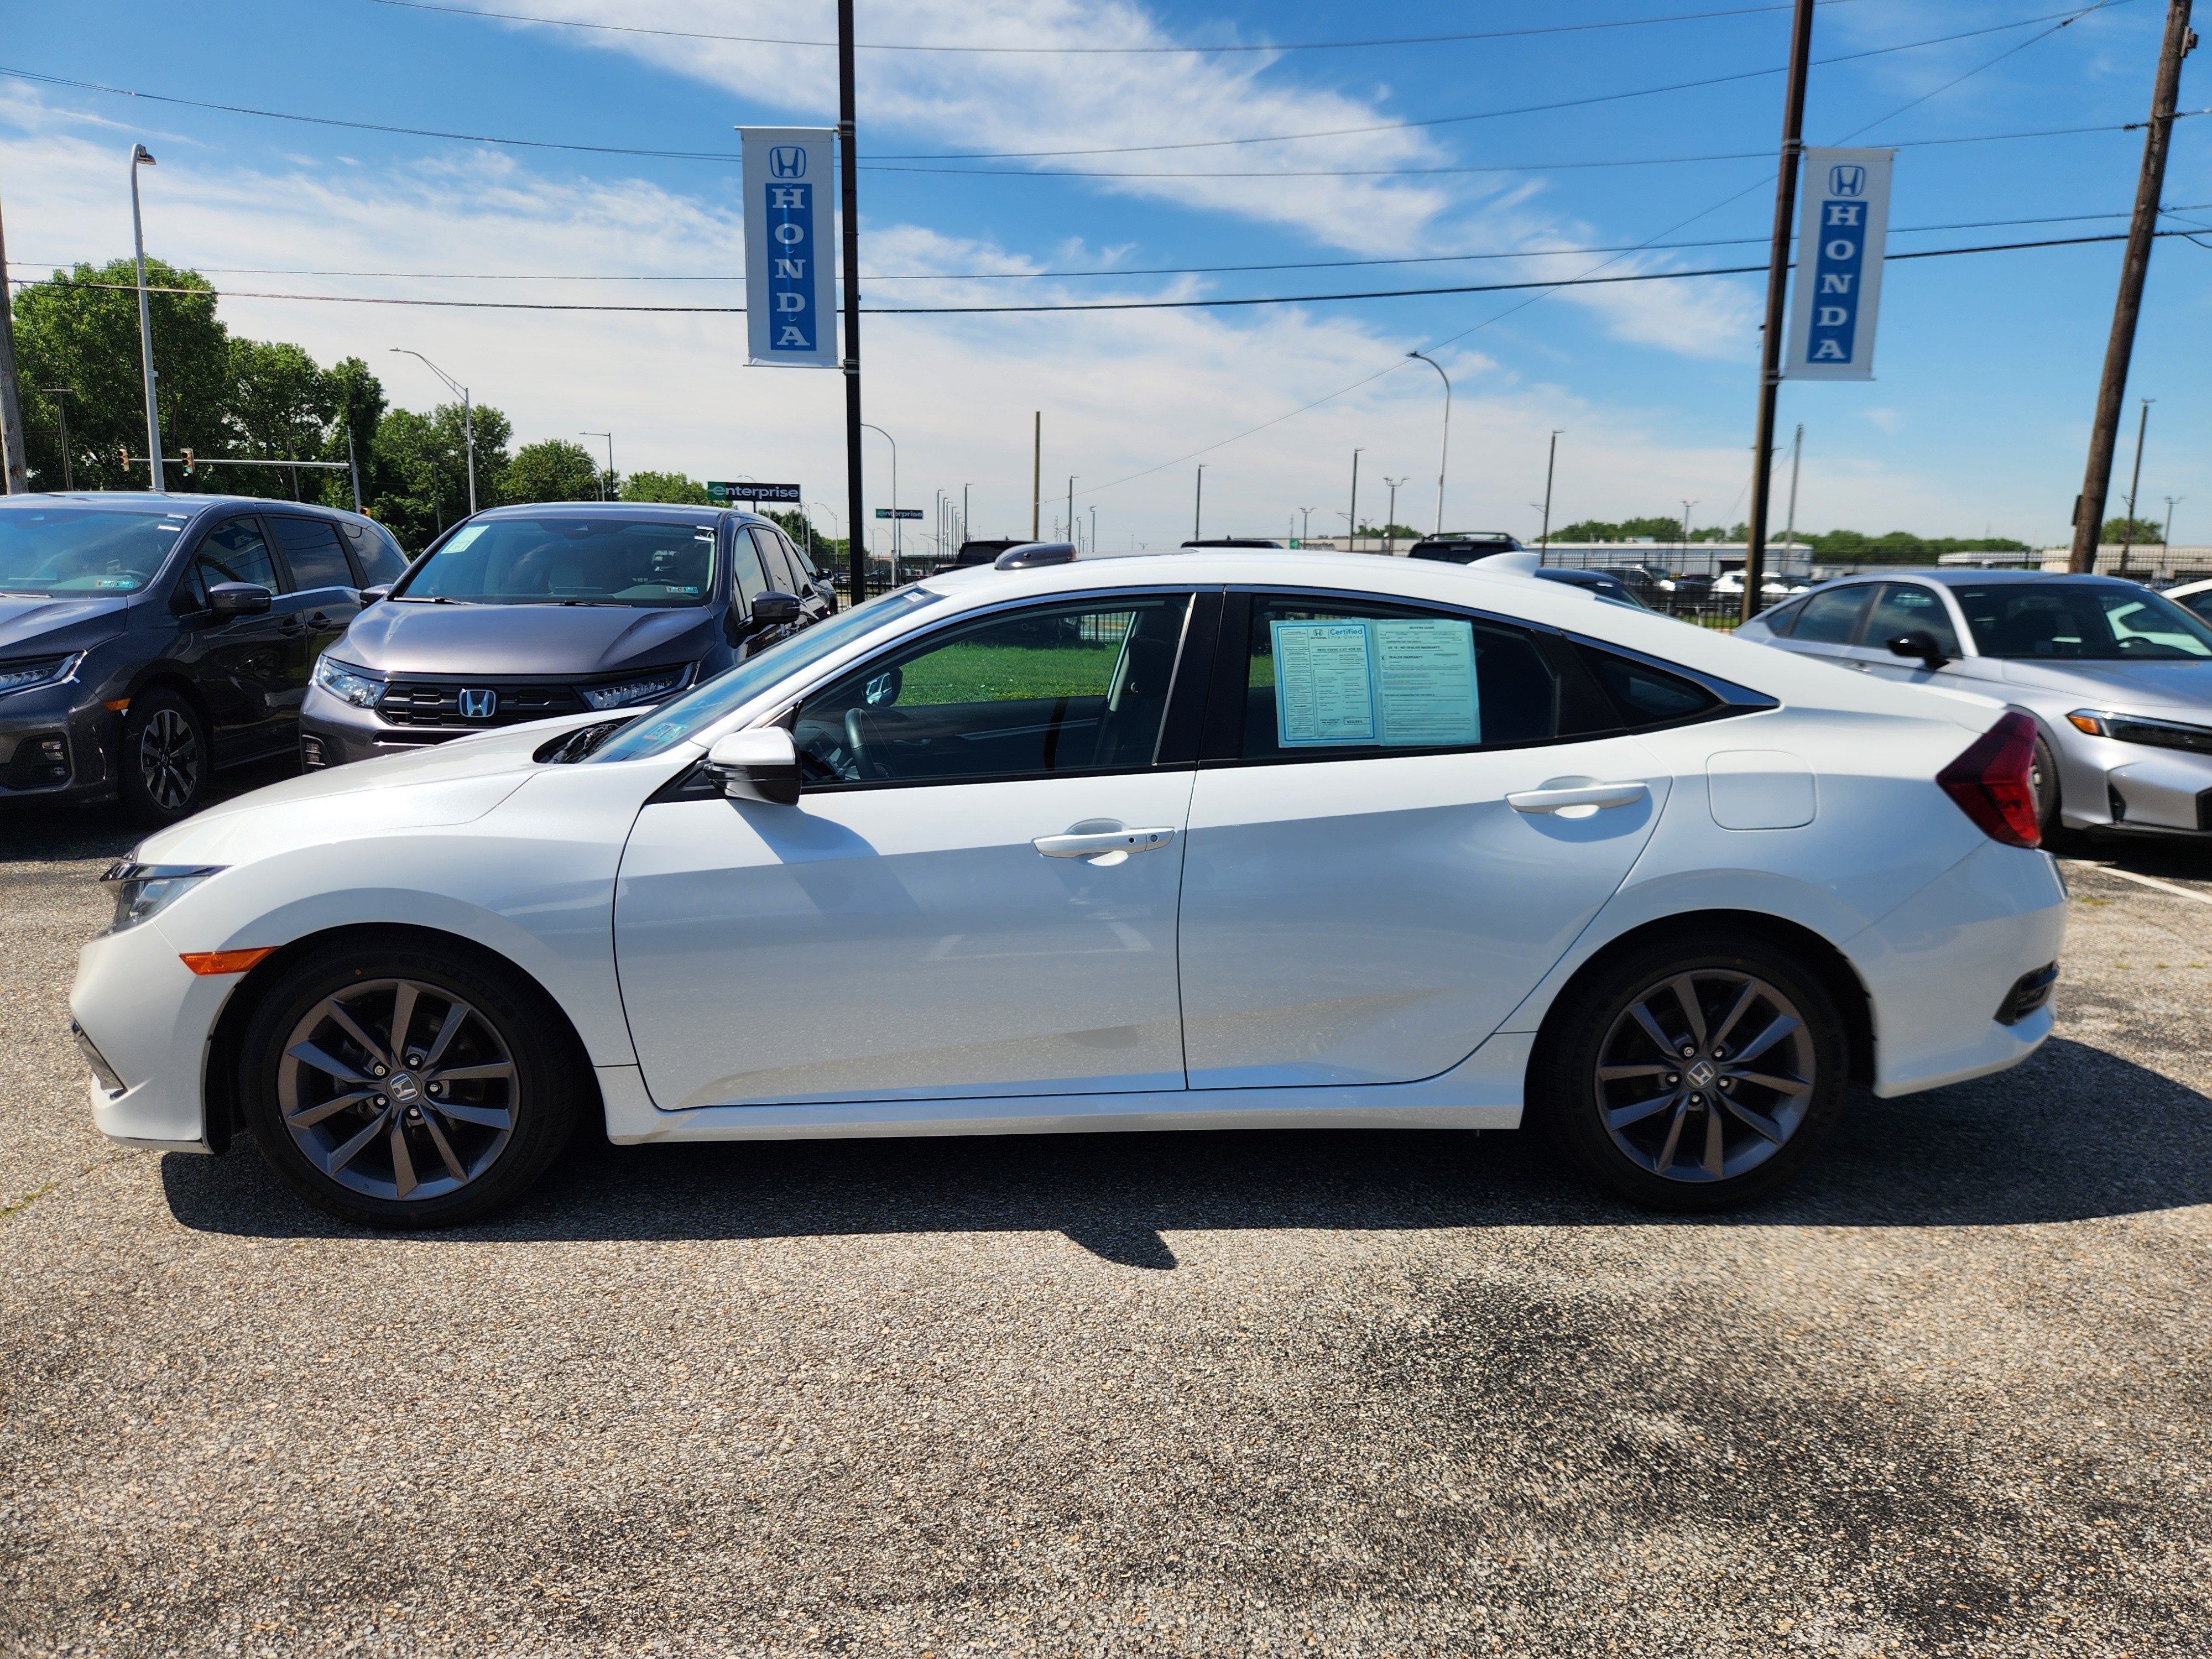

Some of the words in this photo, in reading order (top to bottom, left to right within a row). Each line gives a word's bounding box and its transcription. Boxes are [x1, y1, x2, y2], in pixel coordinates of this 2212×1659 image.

[772, 189, 810, 346] HONDA
[1812, 206, 1860, 359] HONDA
[710, 486, 799, 499] enterprise
